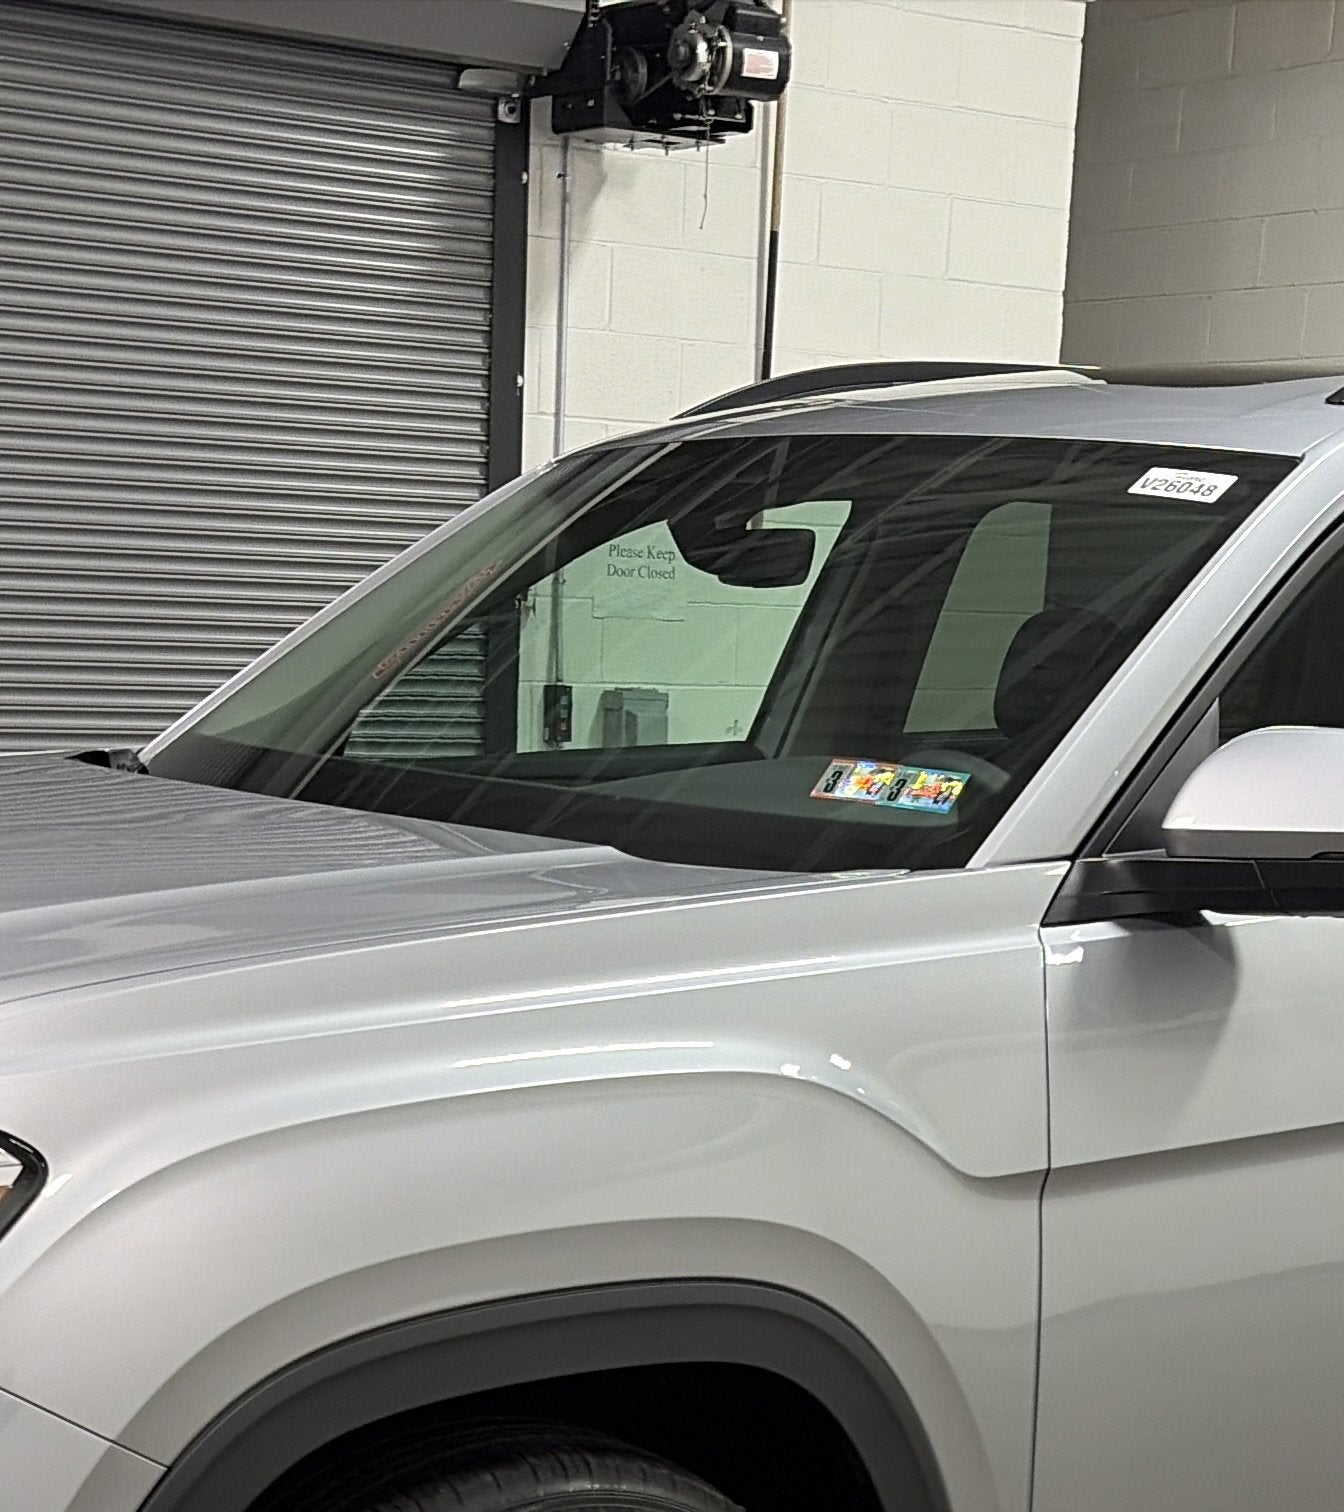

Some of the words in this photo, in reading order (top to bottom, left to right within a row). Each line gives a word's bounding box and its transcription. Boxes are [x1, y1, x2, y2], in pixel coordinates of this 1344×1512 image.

[1140, 477, 1218, 497] V26048
[608, 544, 644, 558] Please
[647, 545, 675, 564] Keep
[607, 563, 636, 577] Door
[638, 565, 675, 579] Closed
[823, 770, 843, 793] 3
[887, 778, 907, 801] 3
